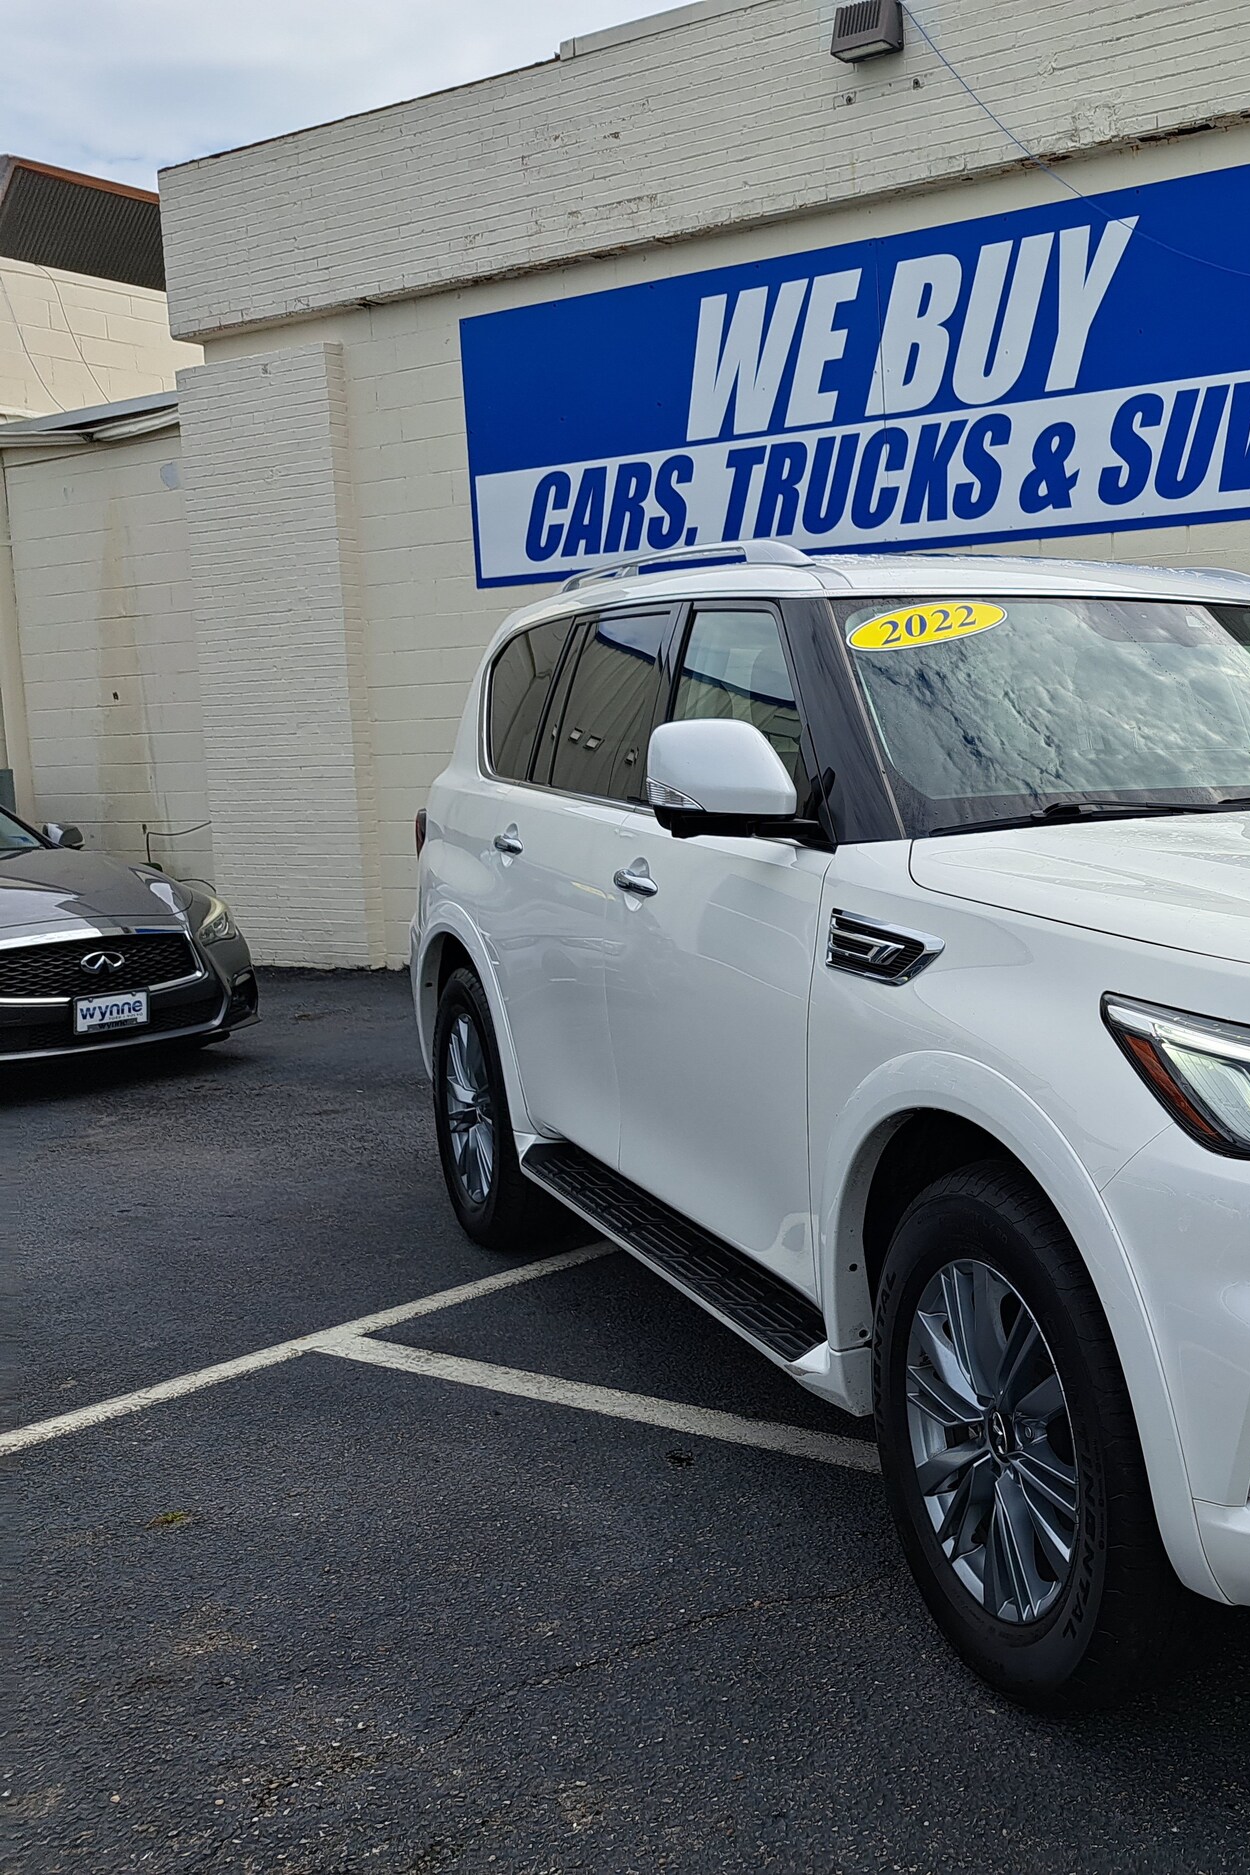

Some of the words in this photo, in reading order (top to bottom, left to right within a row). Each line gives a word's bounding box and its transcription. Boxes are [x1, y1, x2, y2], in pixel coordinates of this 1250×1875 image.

[686, 268, 863, 442] WE
[864, 215, 1140, 417] BUY
[721, 413, 1012, 542] TRUCKS
[1020, 421, 1080, 515] &
[879, 605, 977, 646] 2022
[80, 1000, 143, 1021] wynne
